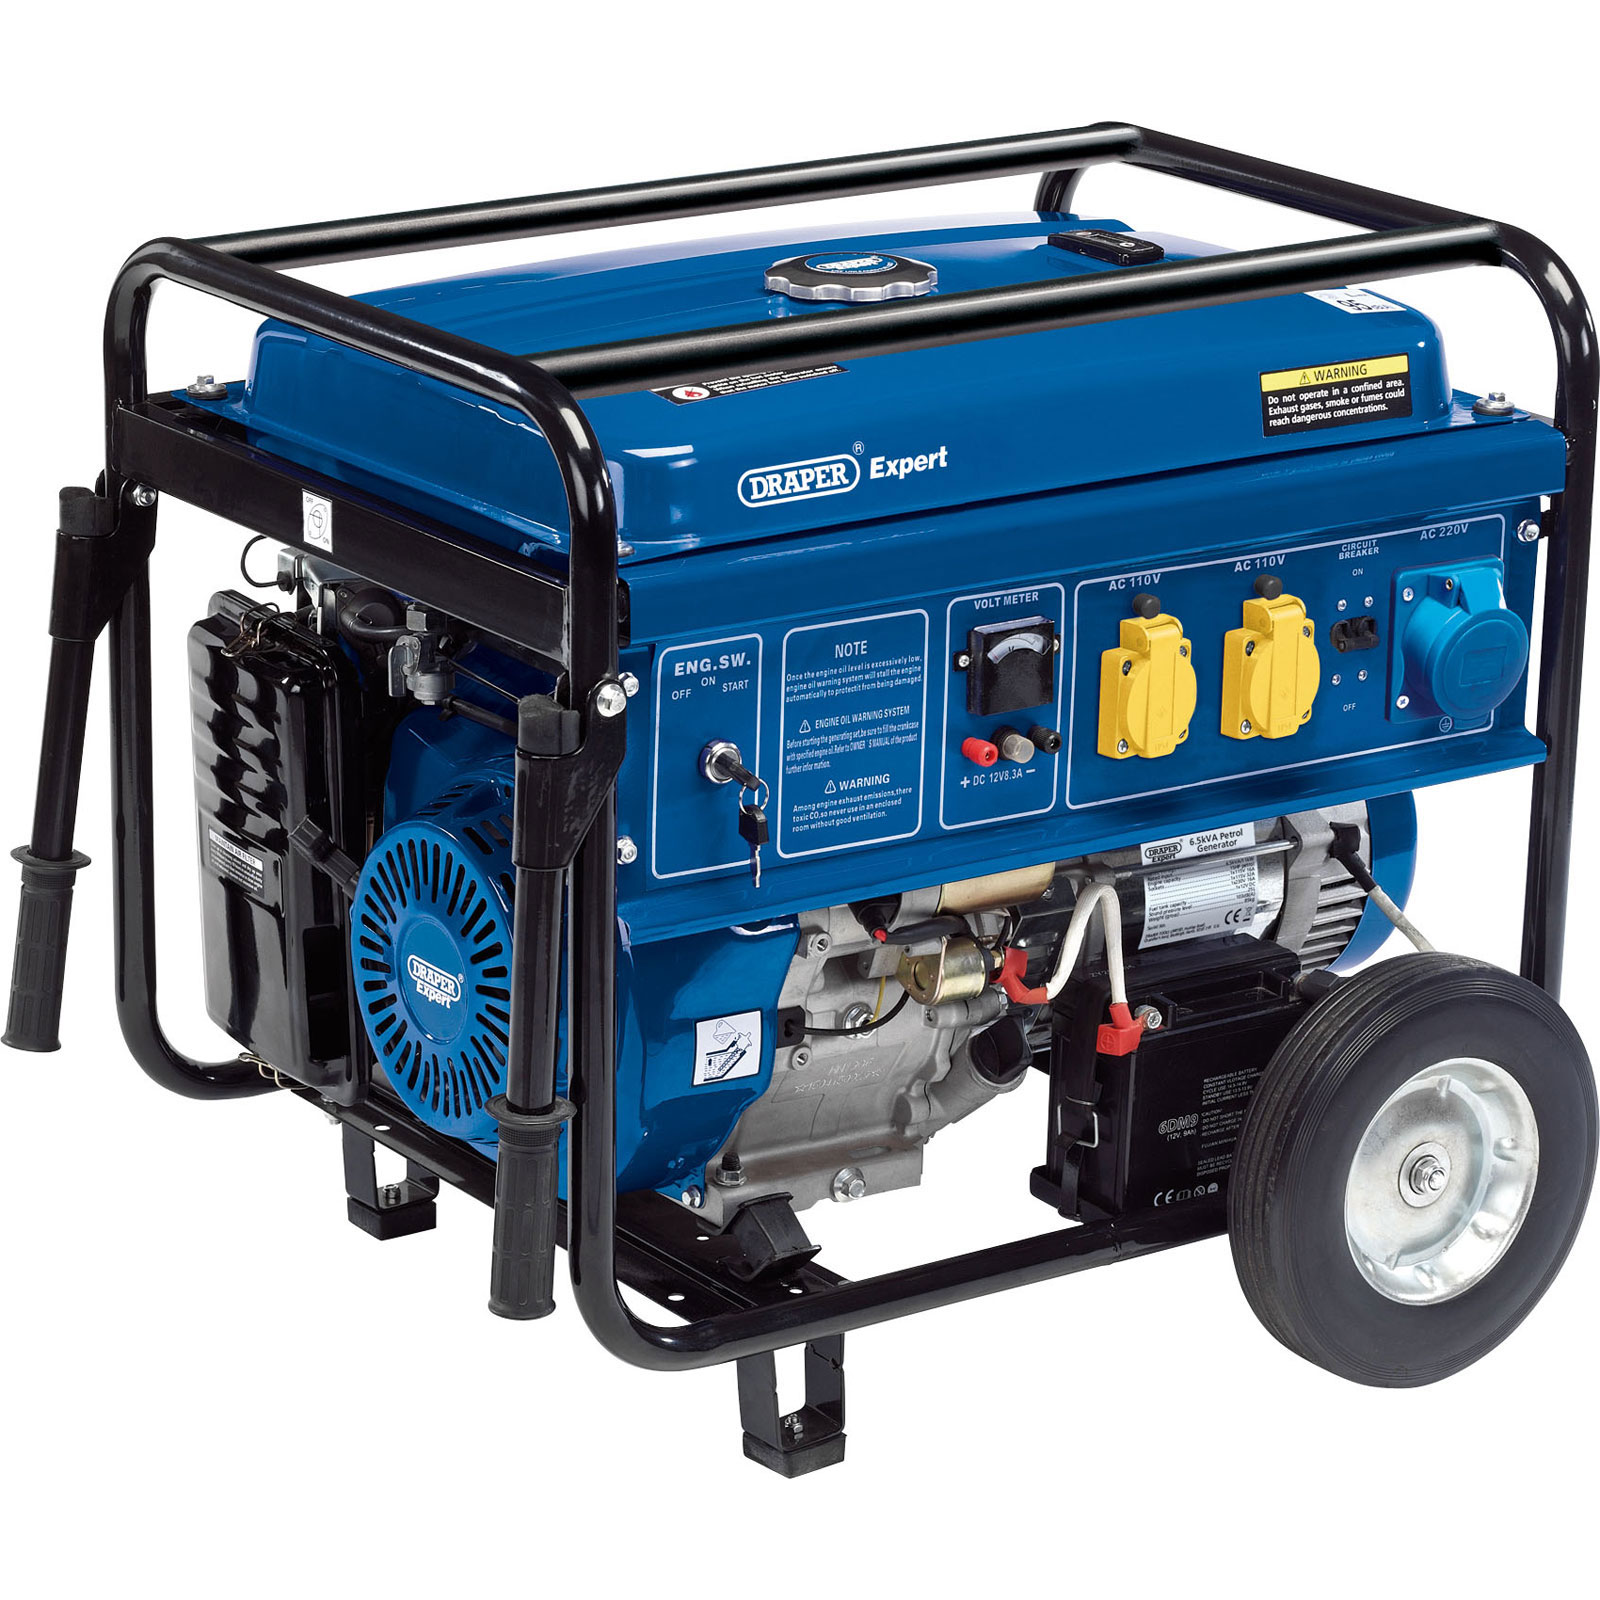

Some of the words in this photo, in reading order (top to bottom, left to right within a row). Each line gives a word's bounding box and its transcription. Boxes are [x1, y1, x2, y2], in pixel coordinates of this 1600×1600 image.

[1314, 364, 1368, 382] WARNING
[1268, 396, 1279, 405] Do
[1282, 394, 1296, 403] not
[1299, 389, 1329, 402] operate
[1332, 386, 1340, 395] in
[1351, 380, 1382, 393] confined
[1386, 379, 1404, 389] area.
[1269, 403, 1299, 415] Exhaust
[1301, 401, 1324, 413] gases,
[1325, 396, 1349, 408] smoke
[1361, 393, 1383, 403] fumes
[1385, 389, 1405, 399] could
[1269, 416, 1291, 427] reach
[1292, 409, 1331, 425] dangerous
[1333, 403, 1388, 418] concentrations.
[749, 463, 849, 499] DRAPER
[870, 446, 948, 479] Expert
[1420, 530, 1436, 541] AC
[1439, 523, 1469, 537] 220V
[1339, 547, 1379, 560] BREAKER
[1342, 539, 1377, 551] CIRCUIT
[1234, 560, 1251, 572] AC
[1255, 554, 1286, 569] 110V
[1108, 578, 1126, 591] AC
[1130, 573, 1161, 588] 110V
[974, 597, 1001, 610] VOLT
[1004, 592, 1039, 605] METER
[835, 640, 868, 659] NOTE
[674, 652, 751, 676] ENG.SW.
[787, 673, 802, 681] Once
[804, 671, 814, 679] the
[816, 668, 837, 678] engine
[839, 665, 847, 673] oil
[848, 662, 863, 672] level
[864, 661, 870, 669] is
[871, 656, 907, 668] excessively
[701, 676, 715, 686] ON
[722, 680, 749, 692] START
[786, 681, 806, 693] engine
[817, 677, 841, 687] warning
[842, 674, 863, 684] system
[865, 671, 875, 679] will
[901, 665, 921, 675] engine
[672, 689, 691, 700] OFF
[786, 690, 827, 702] automatically
[862, 681, 876, 690] from
[877, 679, 893, 689] being
[815, 717, 839, 729] ENGINE
[840, 715, 850, 725] OIL
[852, 709, 883, 723] WARNING
[884, 705, 910, 717] SYSTEM
[1343, 703, 1356, 712] OFF
[787, 739, 801, 749] Before
[802, 736, 820, 747] starting
[829, 731, 852, 744] generating
[867, 727, 876, 736] sure
[897, 721, 919, 730] crankcase
[796, 748, 814, 760] specified
[815, 747, 828, 758] engine
[850, 740, 865, 751] OWNER
[902, 733, 917, 744] product
[786, 764, 802, 774] further
[973, 773, 985, 786] DC
[989, 767, 1023, 783] 12V8.3A
[840, 774, 890, 790] WARNING
[793, 803, 815, 812] Among
[817, 800, 837, 810] engine
[838, 795, 863, 805] exhaust
[864, 787, 912, 800] emissions,there
[793, 813, 808, 822] toxic
[829, 808, 846, 817] never
[875, 798, 902, 808] enclosed
[792, 824, 809, 832] room
[810, 818, 835, 829] without
[836, 815, 851, 827] good
[852, 810, 887, 821] ventilation.
[1189, 835, 1218, 846] 6.5kVA
[1220, 828, 1243, 840] Petrol
[1197, 839, 1237, 852] Generator
[1149, 845, 1179, 857] DRAPER
[1152, 853, 1176, 863] Expert
[412, 960, 456, 997] DRAPER
[416, 979, 451, 1008] Expert
[1158, 1113, 1199, 1135] 6DM9
[1154, 1189, 1174, 1207] CE
